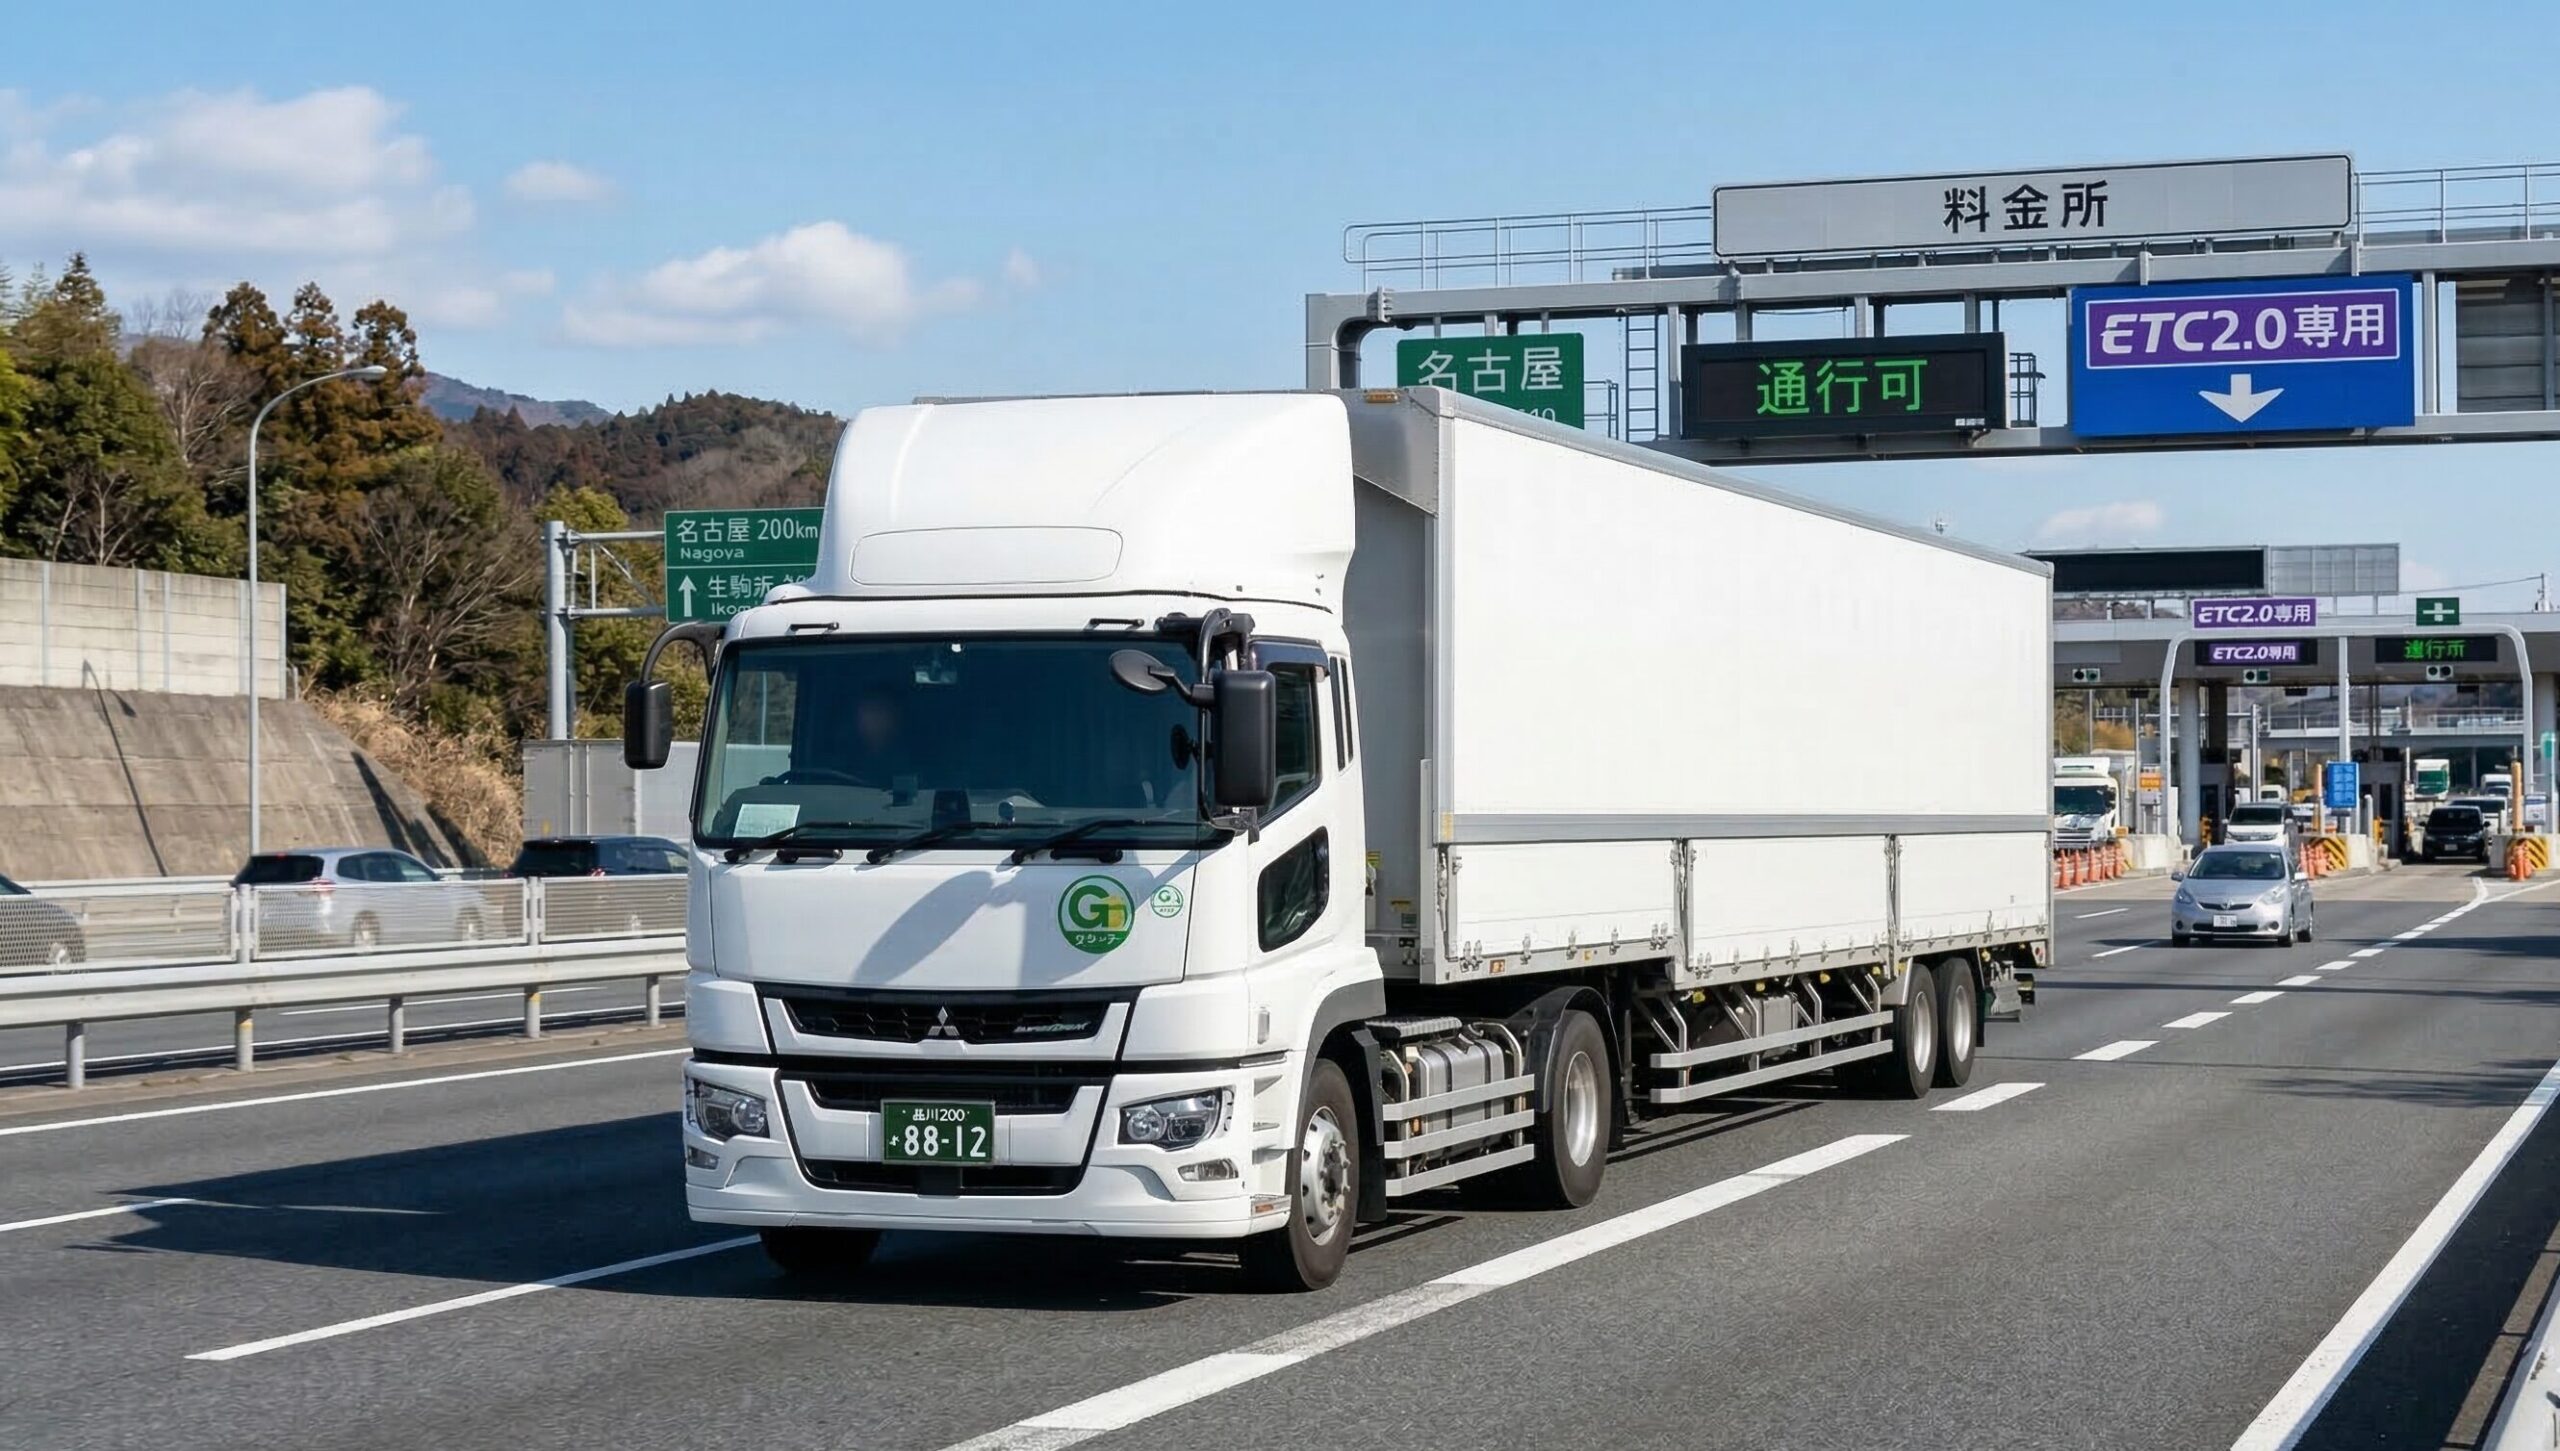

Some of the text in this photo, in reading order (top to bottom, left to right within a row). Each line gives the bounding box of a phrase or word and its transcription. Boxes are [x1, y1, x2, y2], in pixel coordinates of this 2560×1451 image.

[1944, 179, 2109, 233] 料金所
[2101, 303, 2385, 354] ETC2.0専用
[1418, 347, 1563, 394] 名古屋
[1756, 359, 1929, 415] 通行可
[676, 517, 819, 543] 名古屋 200km
[680, 547, 745, 563] Nagoya
[2198, 604, 2311, 623] ETC2.0専用
[904, 1125, 986, 1158] 88-12
